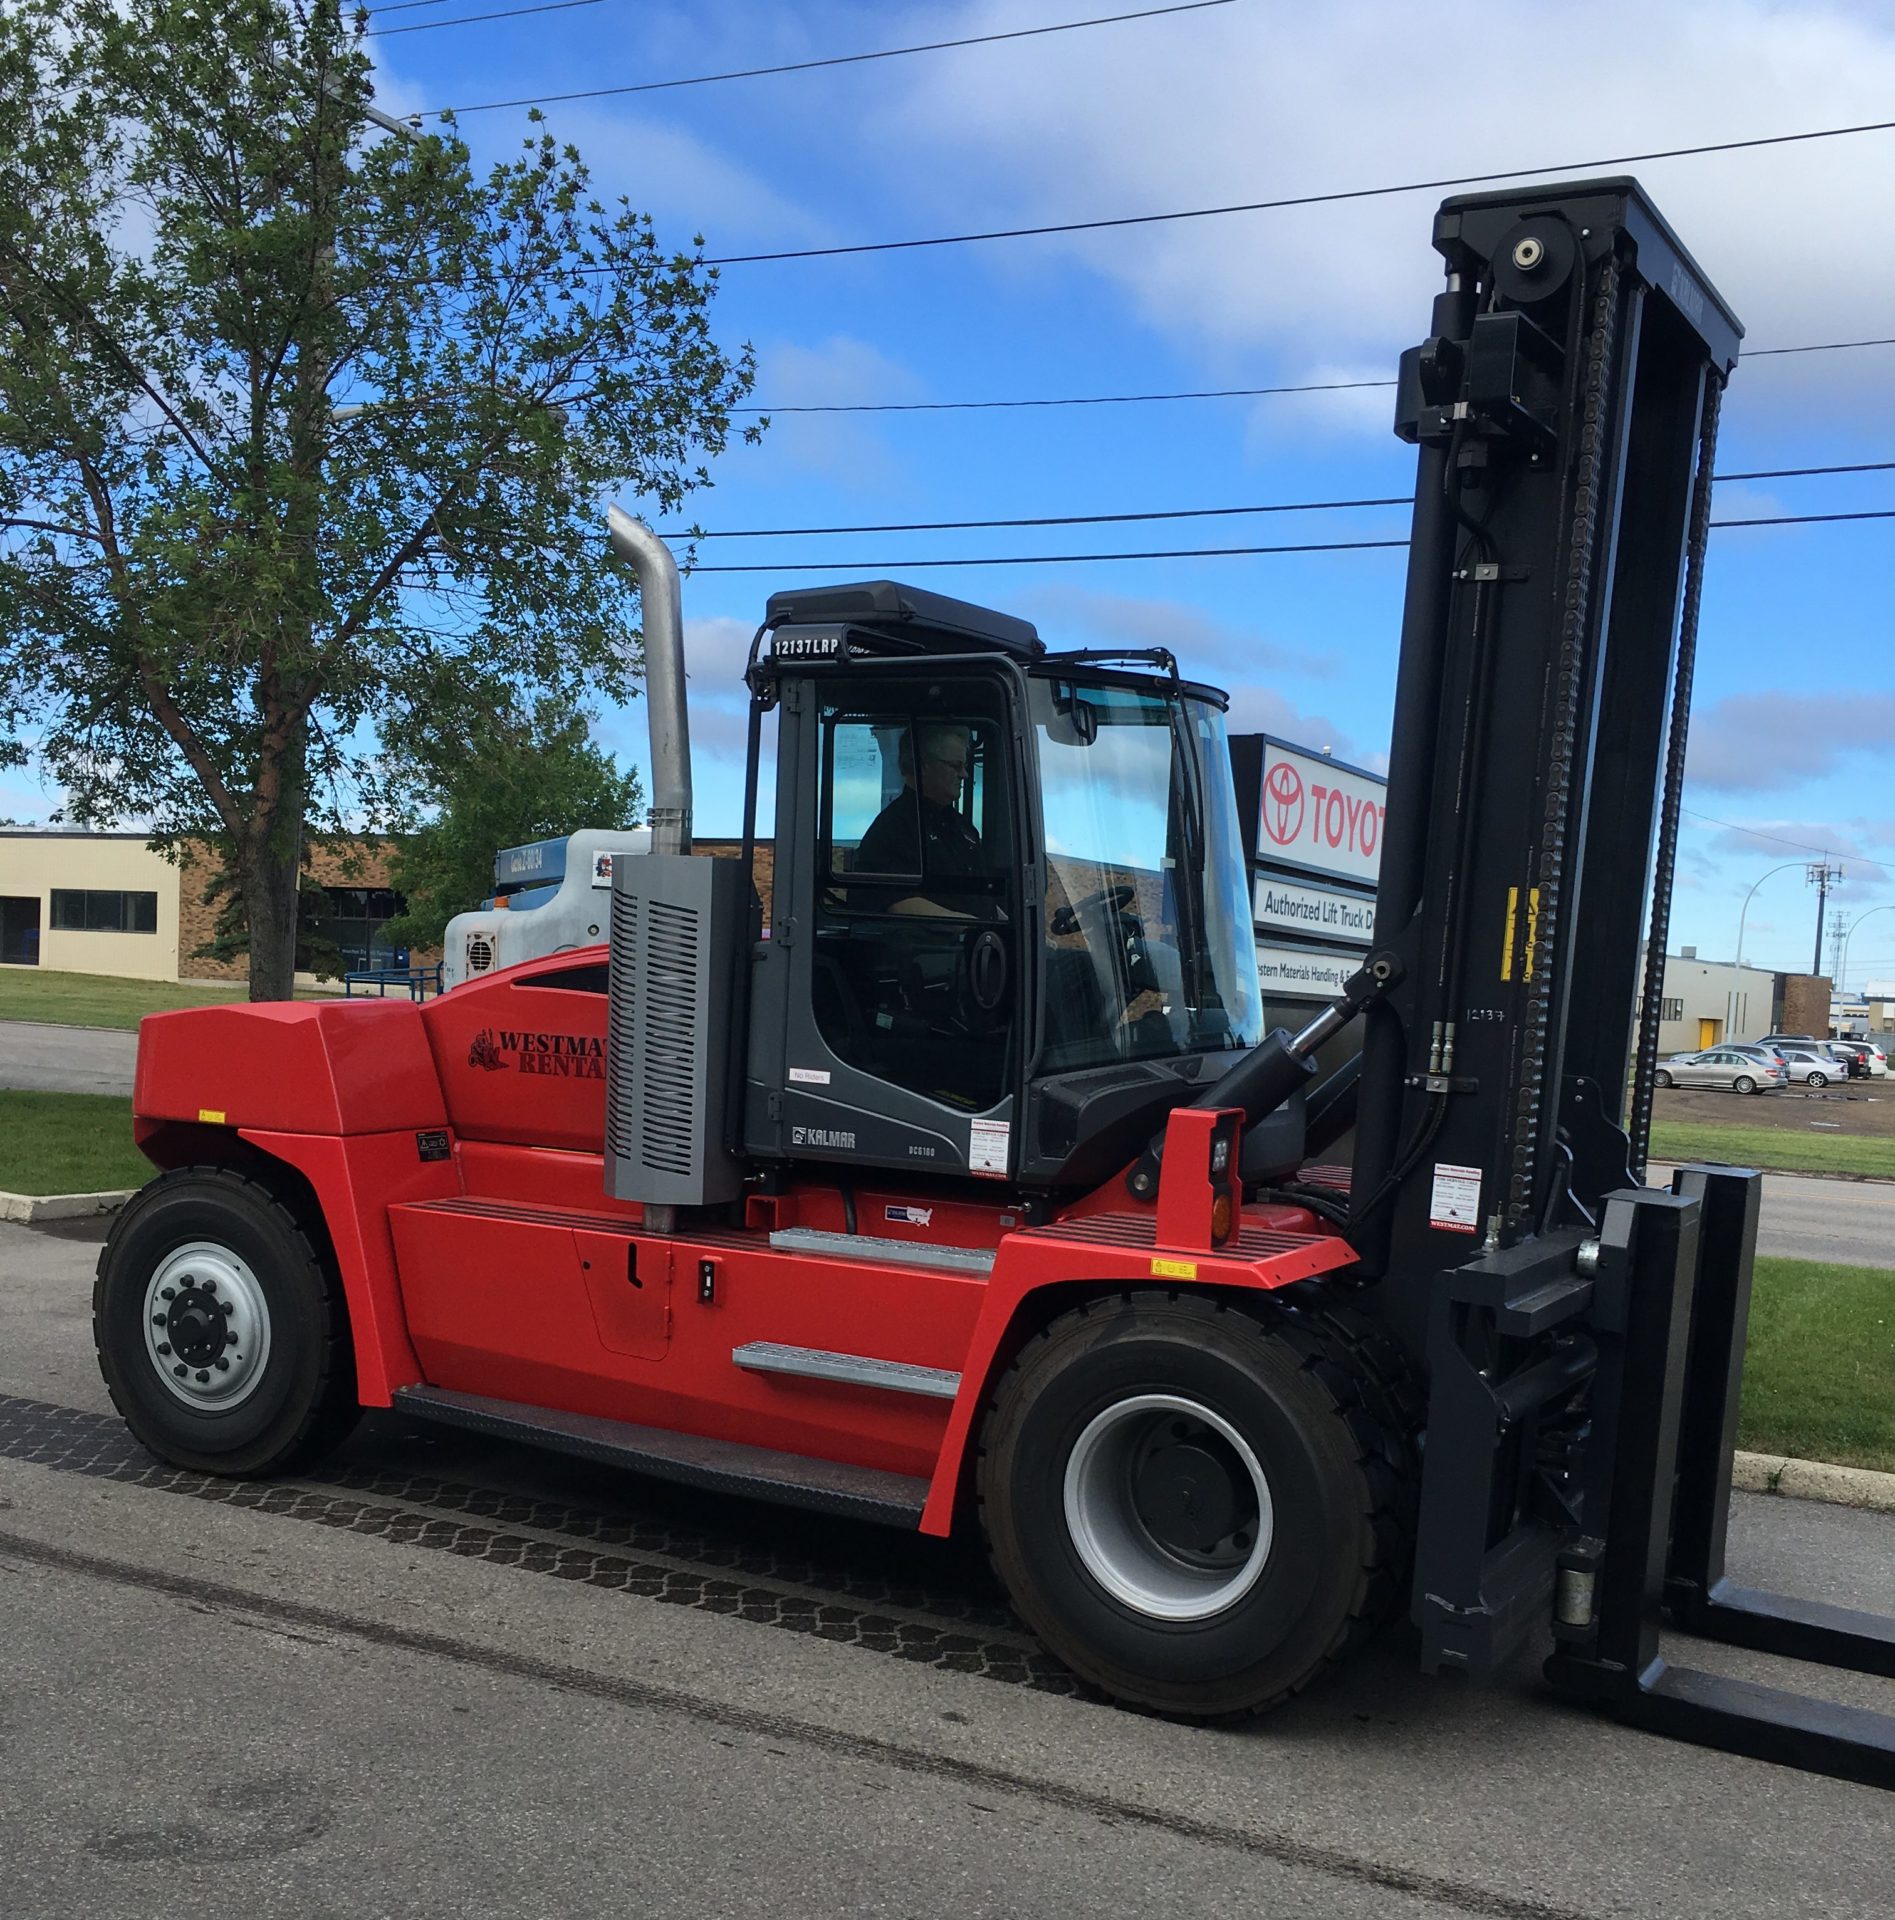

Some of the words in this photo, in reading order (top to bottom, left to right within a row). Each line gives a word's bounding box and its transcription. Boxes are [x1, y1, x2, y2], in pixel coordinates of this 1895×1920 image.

[775, 639, 838, 656] 12137LRP
[1264, 890, 1320, 921] Authorized
[1322, 901, 1338, 924] Lift
[1340, 904, 1364, 929] Truck
[1365, 909, 1375, 930] D
[1279, 963, 1310, 981] Materials
[1311, 966, 1339, 988] Handling
[518, 1052, 607, 1080] RENTA
[794, 1071, 804, 1079] No
[807, 1128, 856, 1149] KALMAR
